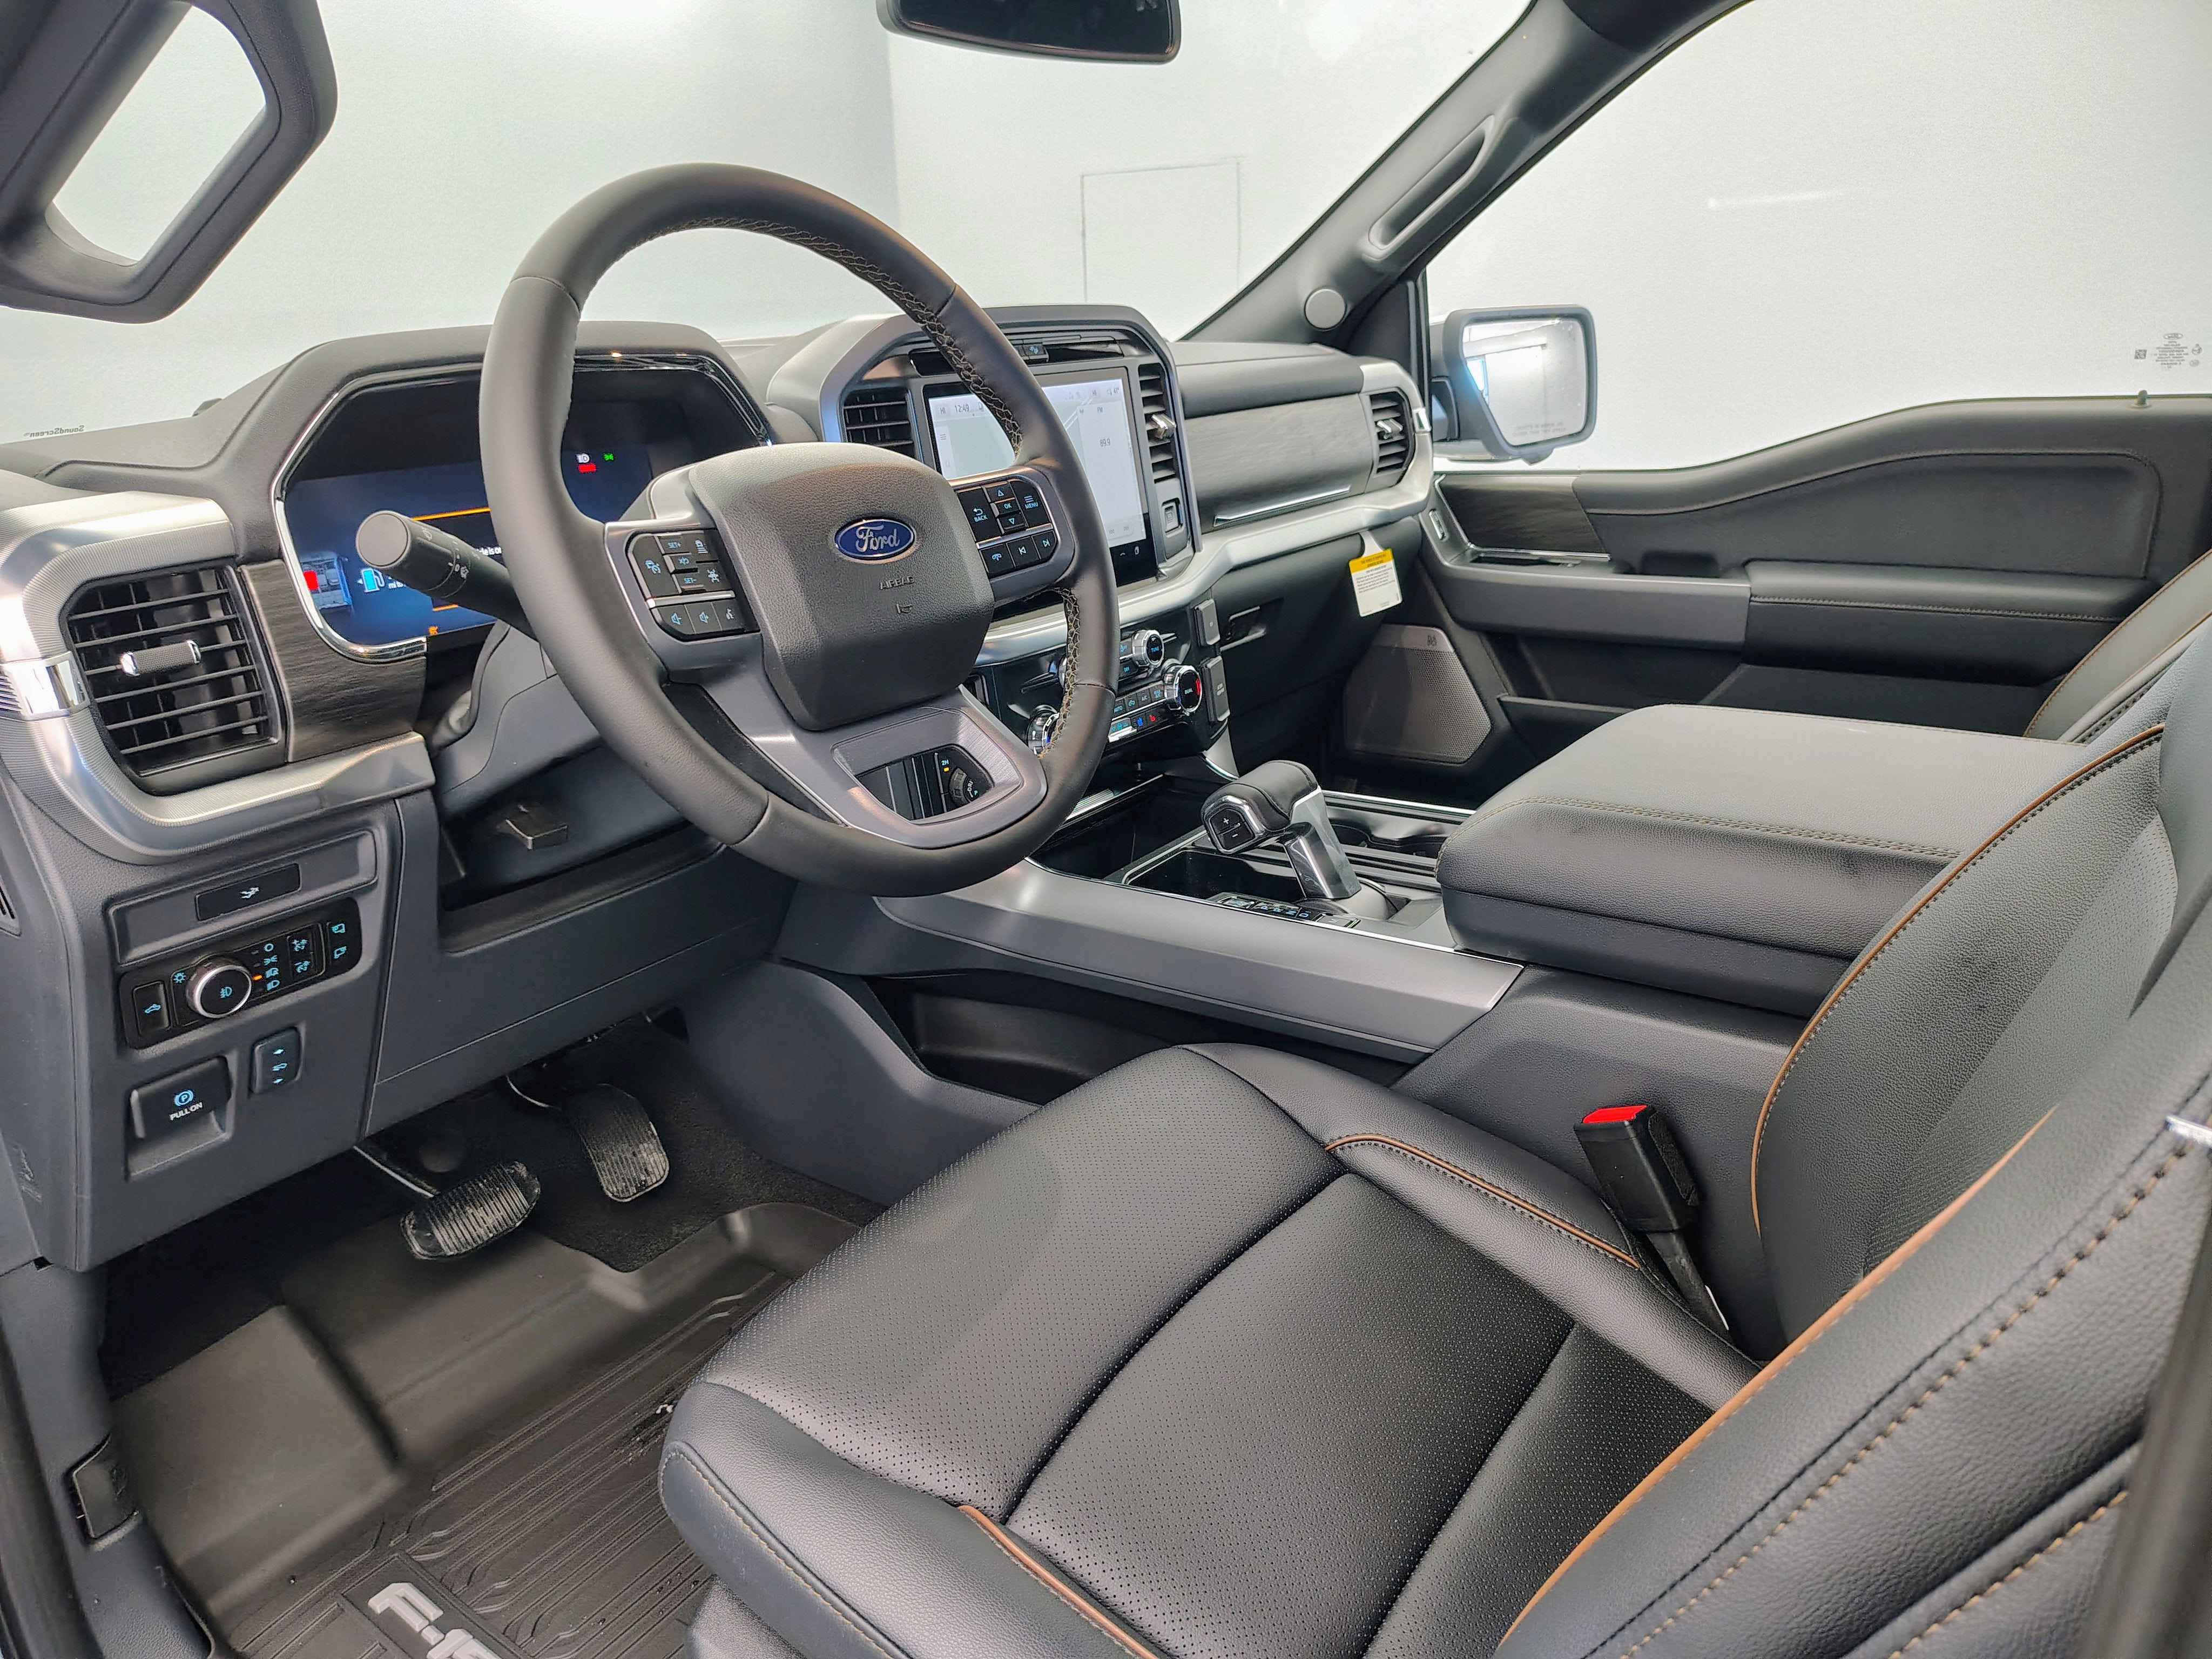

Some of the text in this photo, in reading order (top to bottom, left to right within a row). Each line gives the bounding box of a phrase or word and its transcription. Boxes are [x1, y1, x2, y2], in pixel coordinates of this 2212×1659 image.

[955, 404, 969, 413] 12:49
[1100, 438, 1110, 447] 89.9
[855, 525, 900, 552] Ford
[880, 576, 915, 590] AIRBAG
[169, 1102, 203, 1121] PULL ON
